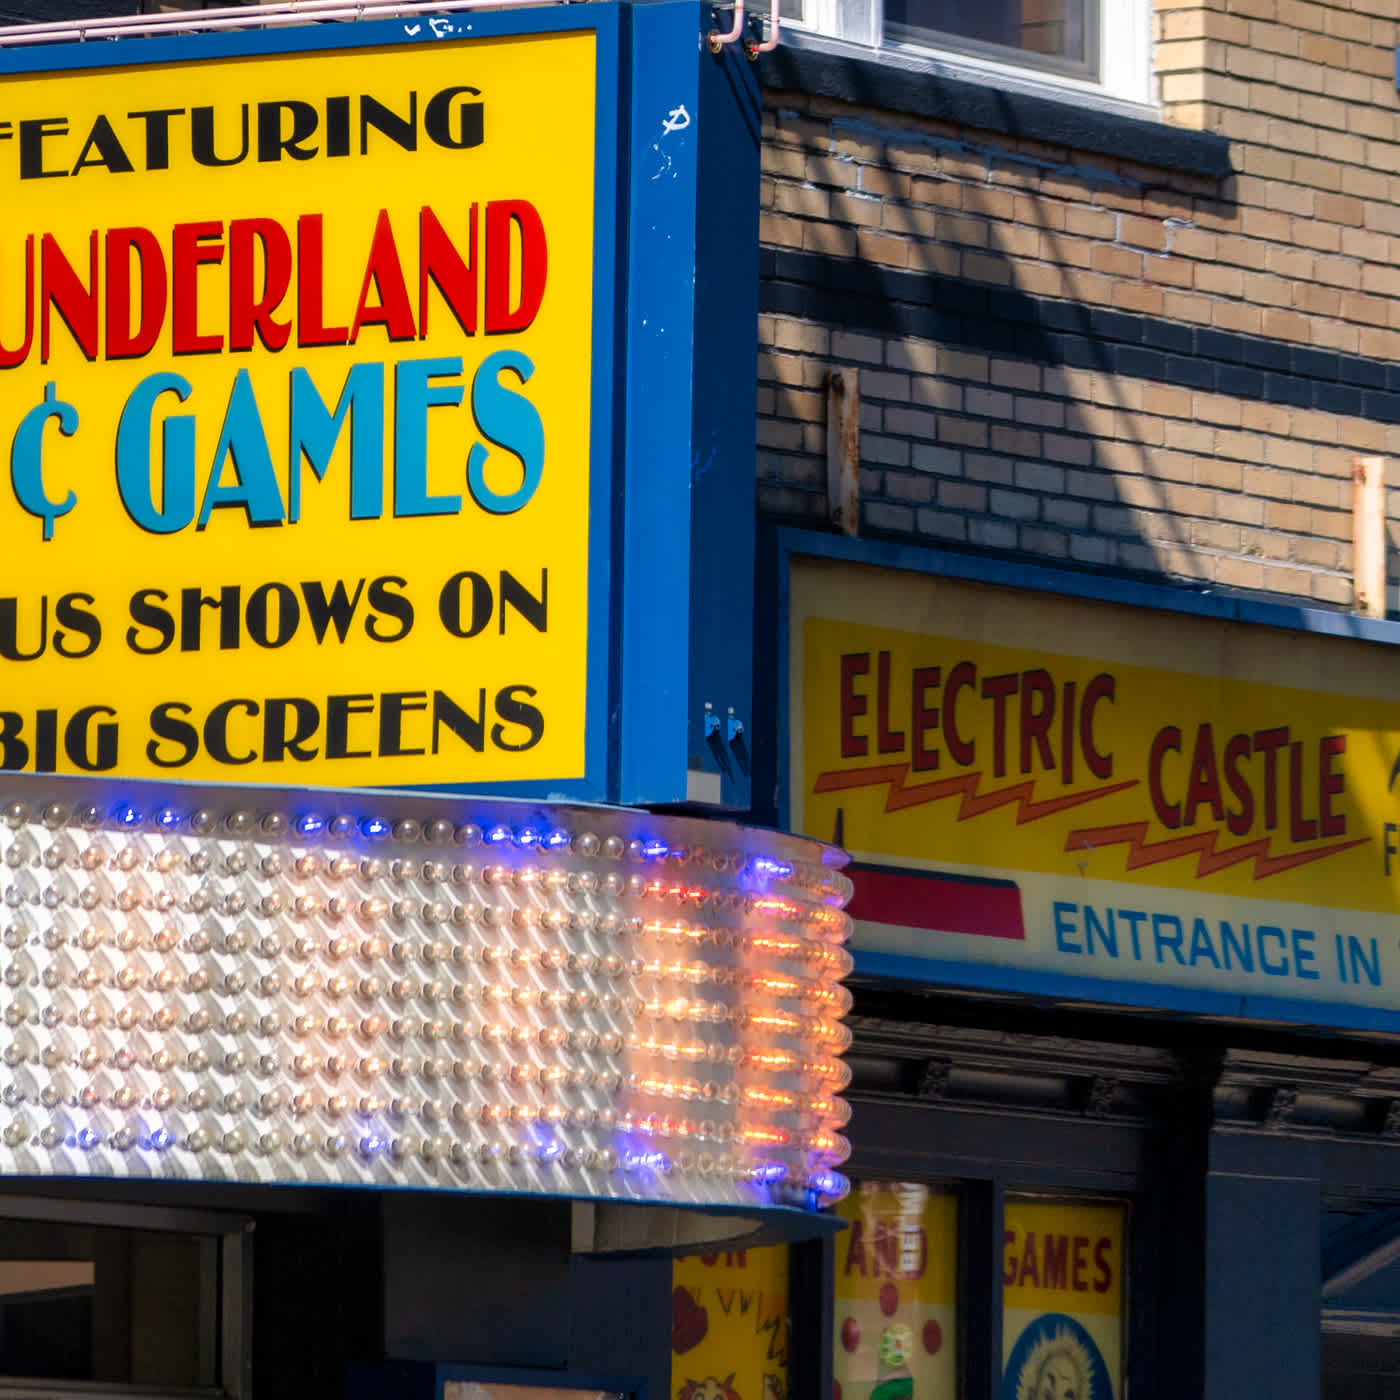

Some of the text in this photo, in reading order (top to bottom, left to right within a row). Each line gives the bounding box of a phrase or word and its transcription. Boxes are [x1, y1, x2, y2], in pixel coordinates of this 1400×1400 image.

[115, 350, 547, 535] GAMES
[125, 574, 415, 655] SHOWS
[438, 567, 550, 640] ON
[145, 683, 545, 768] SCREENS
[841, 650, 1115, 785] ELECTRIC
[1149, 723, 1348, 843] CASTLE
[1052, 901, 1383, 987] ENTRANCE IN
